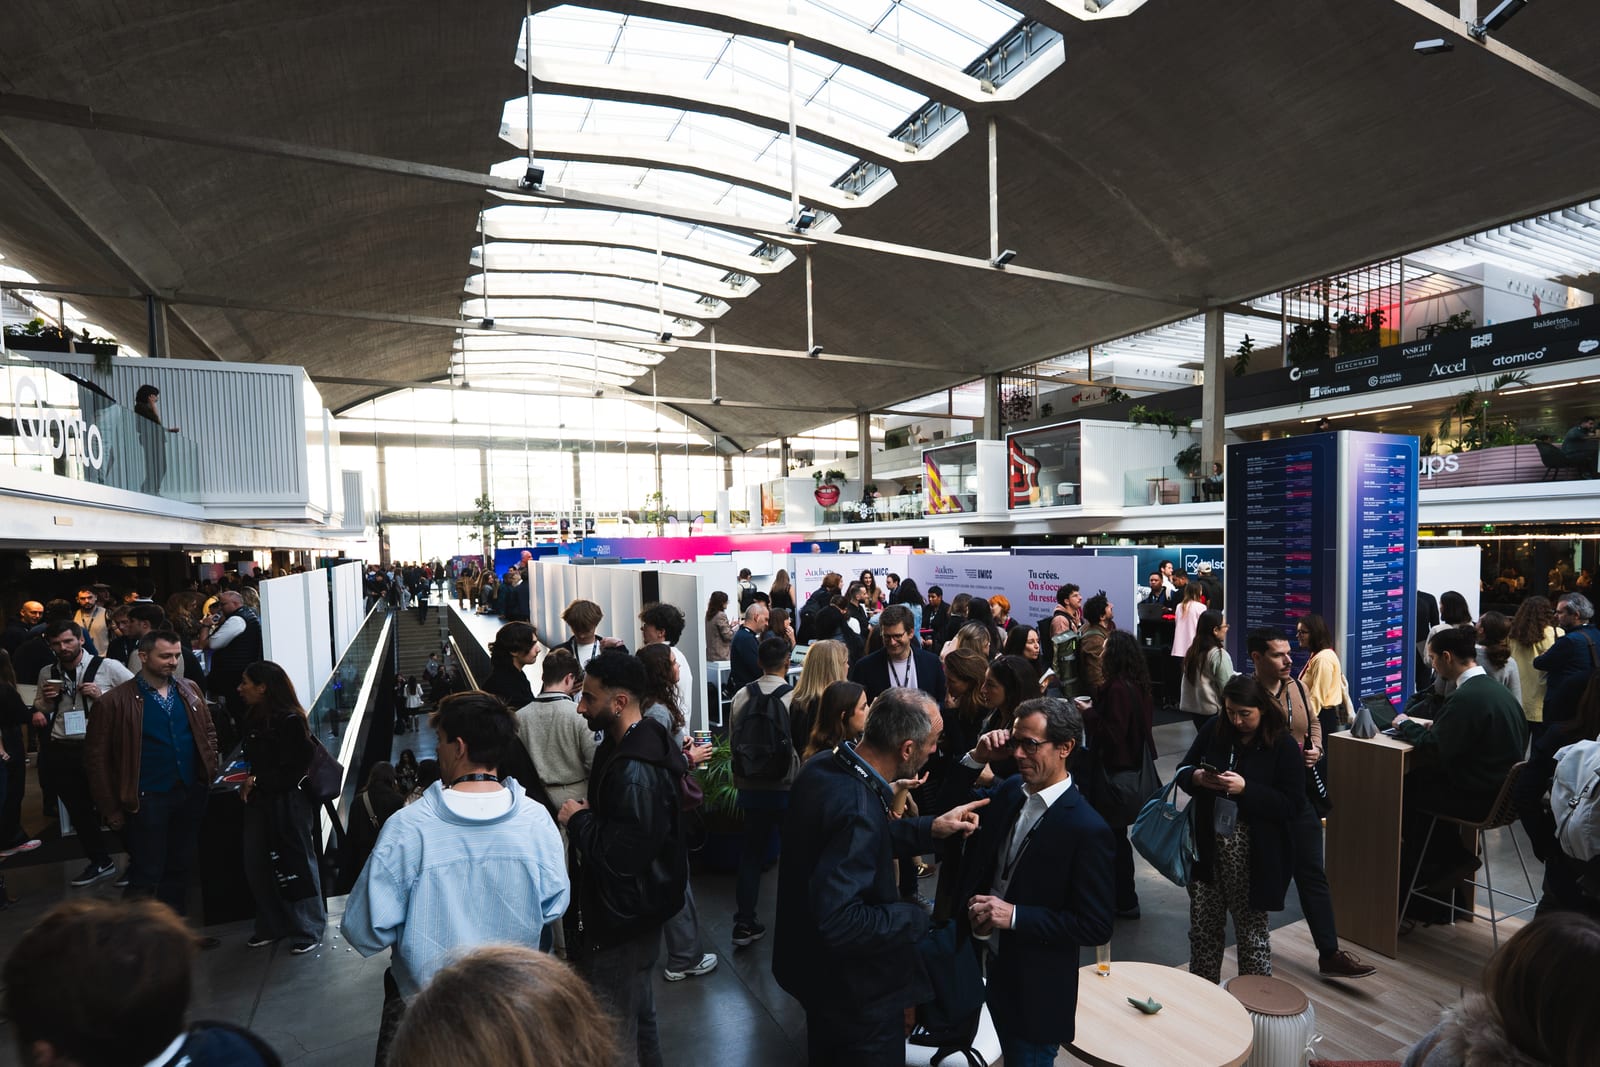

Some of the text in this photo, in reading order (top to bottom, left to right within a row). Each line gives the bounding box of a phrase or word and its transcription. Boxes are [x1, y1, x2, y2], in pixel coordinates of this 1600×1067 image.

[1533, 317, 1570, 329] Balderton
[1402, 344, 1433, 356] INSIGHT
[1492, 349, 1545, 366] atomico
[1336, 358, 1377, 370] BENCHMARK
[1428, 358, 1467, 377] Accel
[1379, 372, 1402, 380] GENERAL
[1379, 376, 1402, 384] CATALYST
[1320, 385, 1351, 396] VENTURES
[15, 375, 103, 470] Qonto
[1028, 569, 1060, 580] Tu crées.
[1028, 580, 1039, 590] On
[1028, 592, 1038, 602] du
